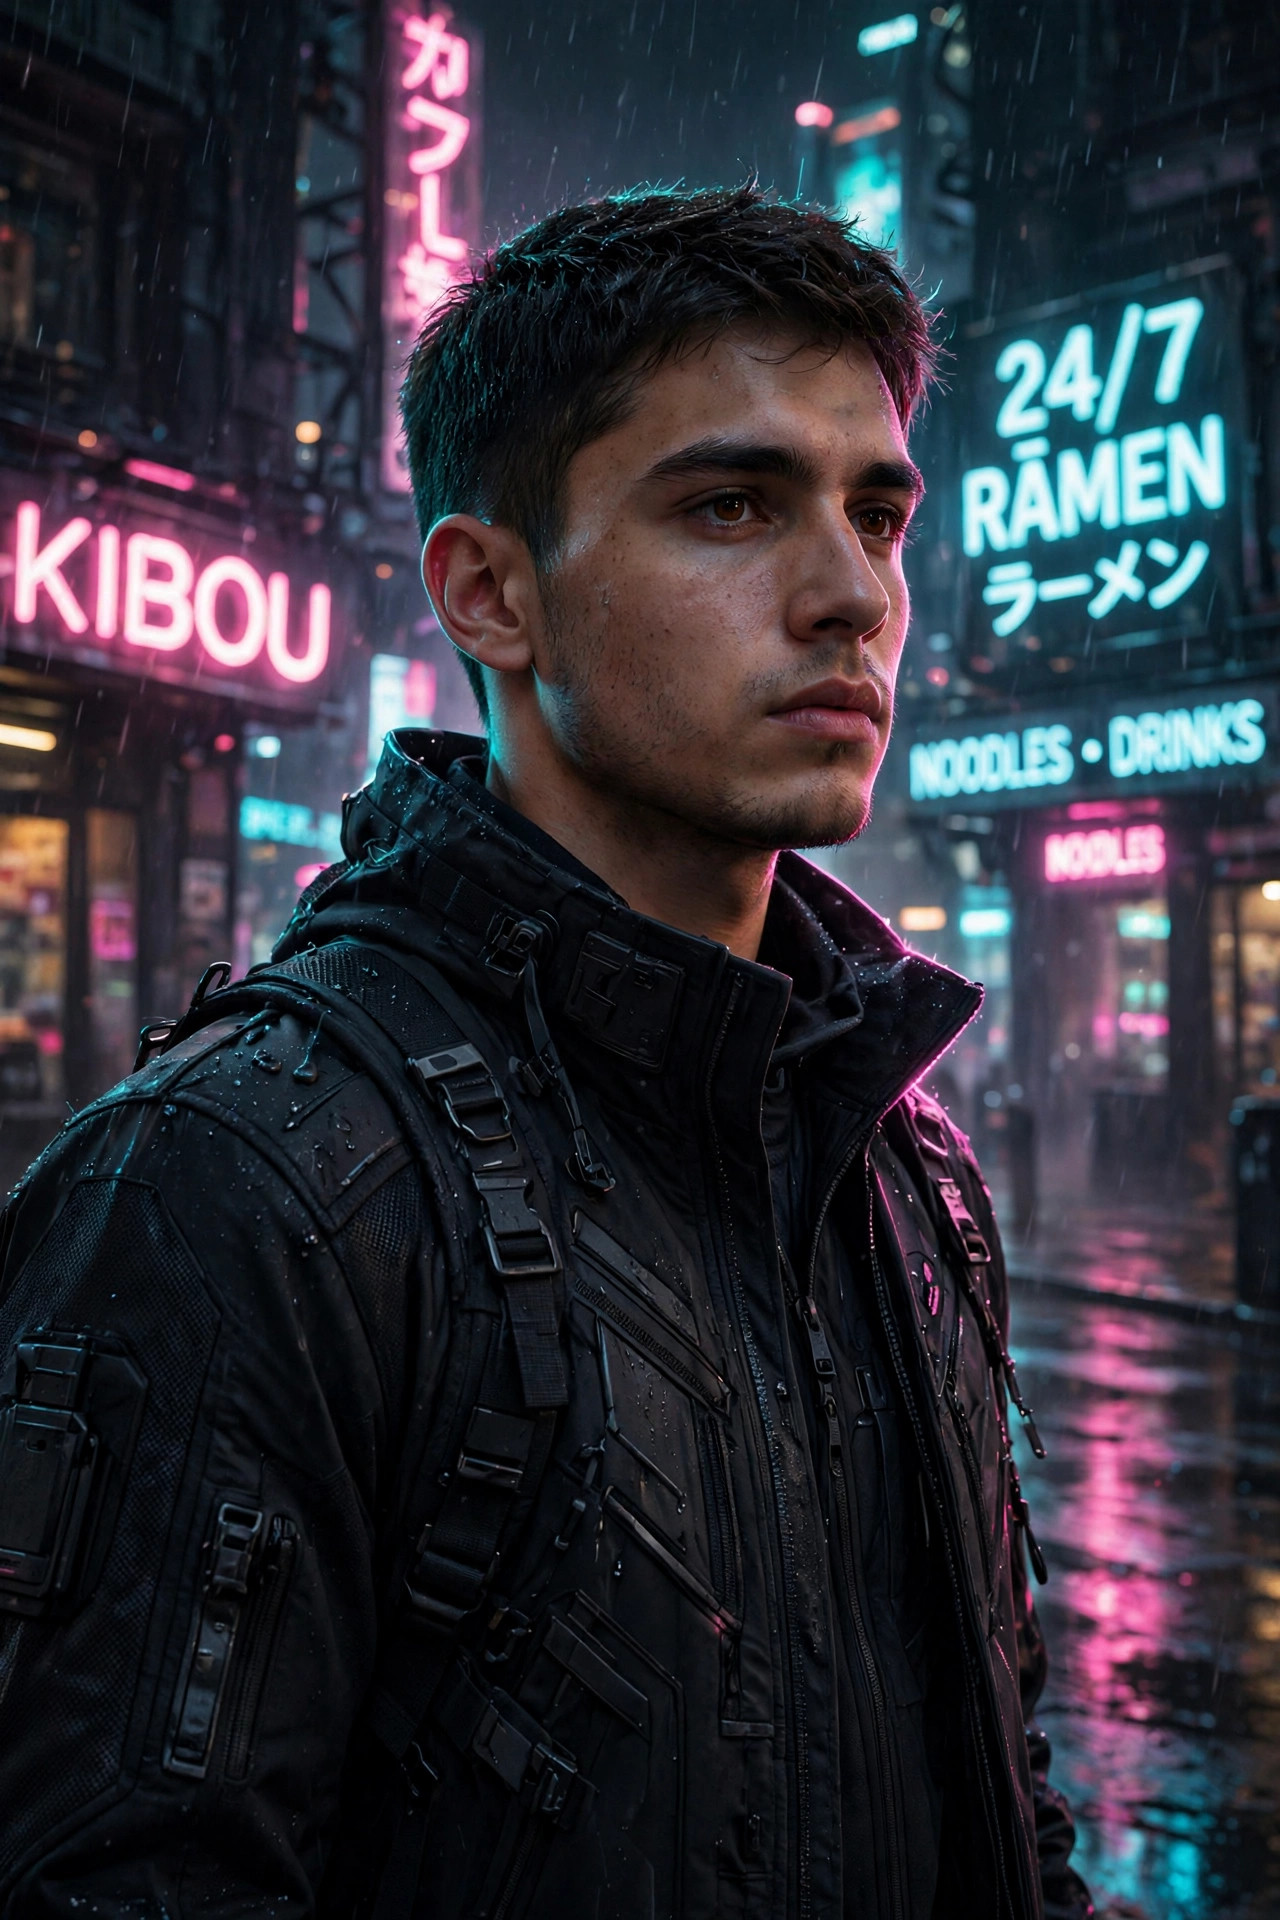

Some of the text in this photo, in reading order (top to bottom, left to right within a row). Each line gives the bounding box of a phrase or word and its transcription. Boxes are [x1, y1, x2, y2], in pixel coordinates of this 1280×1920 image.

[995, 297, 1205, 438] 24/7
[13, 500, 331, 684] KIBOU
[983, 538, 1210, 638] ラーメン
[909, 724, 1074, 800] NOODLES
[1108, 698, 1265, 778] DRINKS
